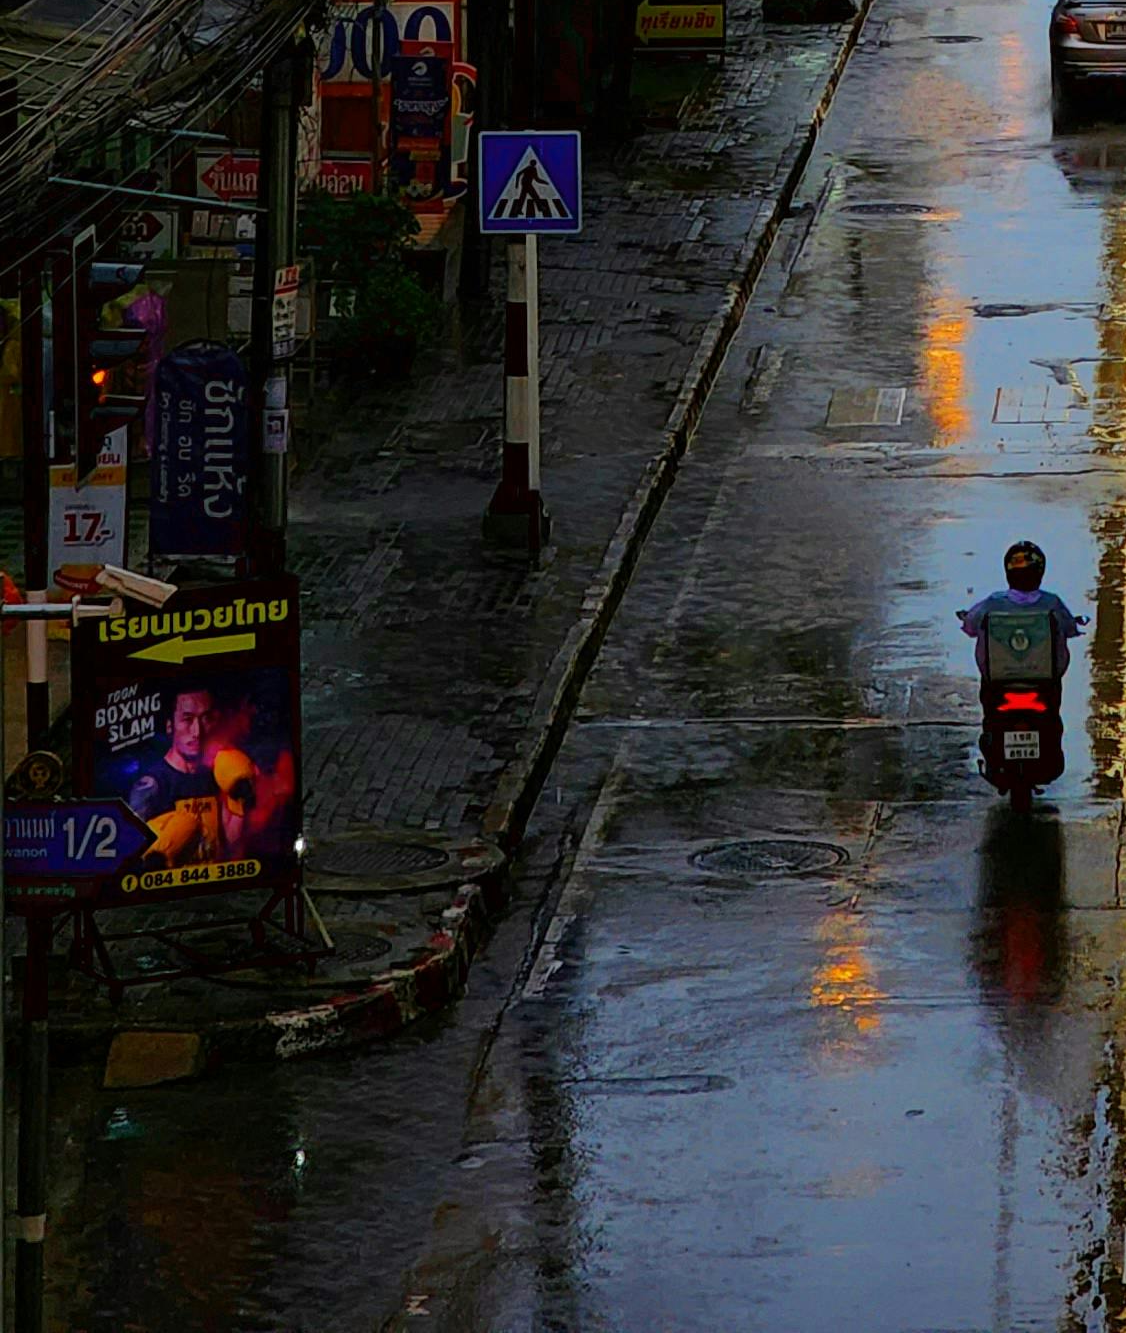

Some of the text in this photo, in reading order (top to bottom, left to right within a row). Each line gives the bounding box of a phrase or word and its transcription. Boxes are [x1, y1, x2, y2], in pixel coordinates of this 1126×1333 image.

[98, 597, 289, 644] เรียนมวยไทย
[95, 692, 161, 730] BOXING
[107, 716, 156, 743] SLAM
[63, 813, 117, 860] 1/2
[144, 860, 256, 888] 084 844 3888
